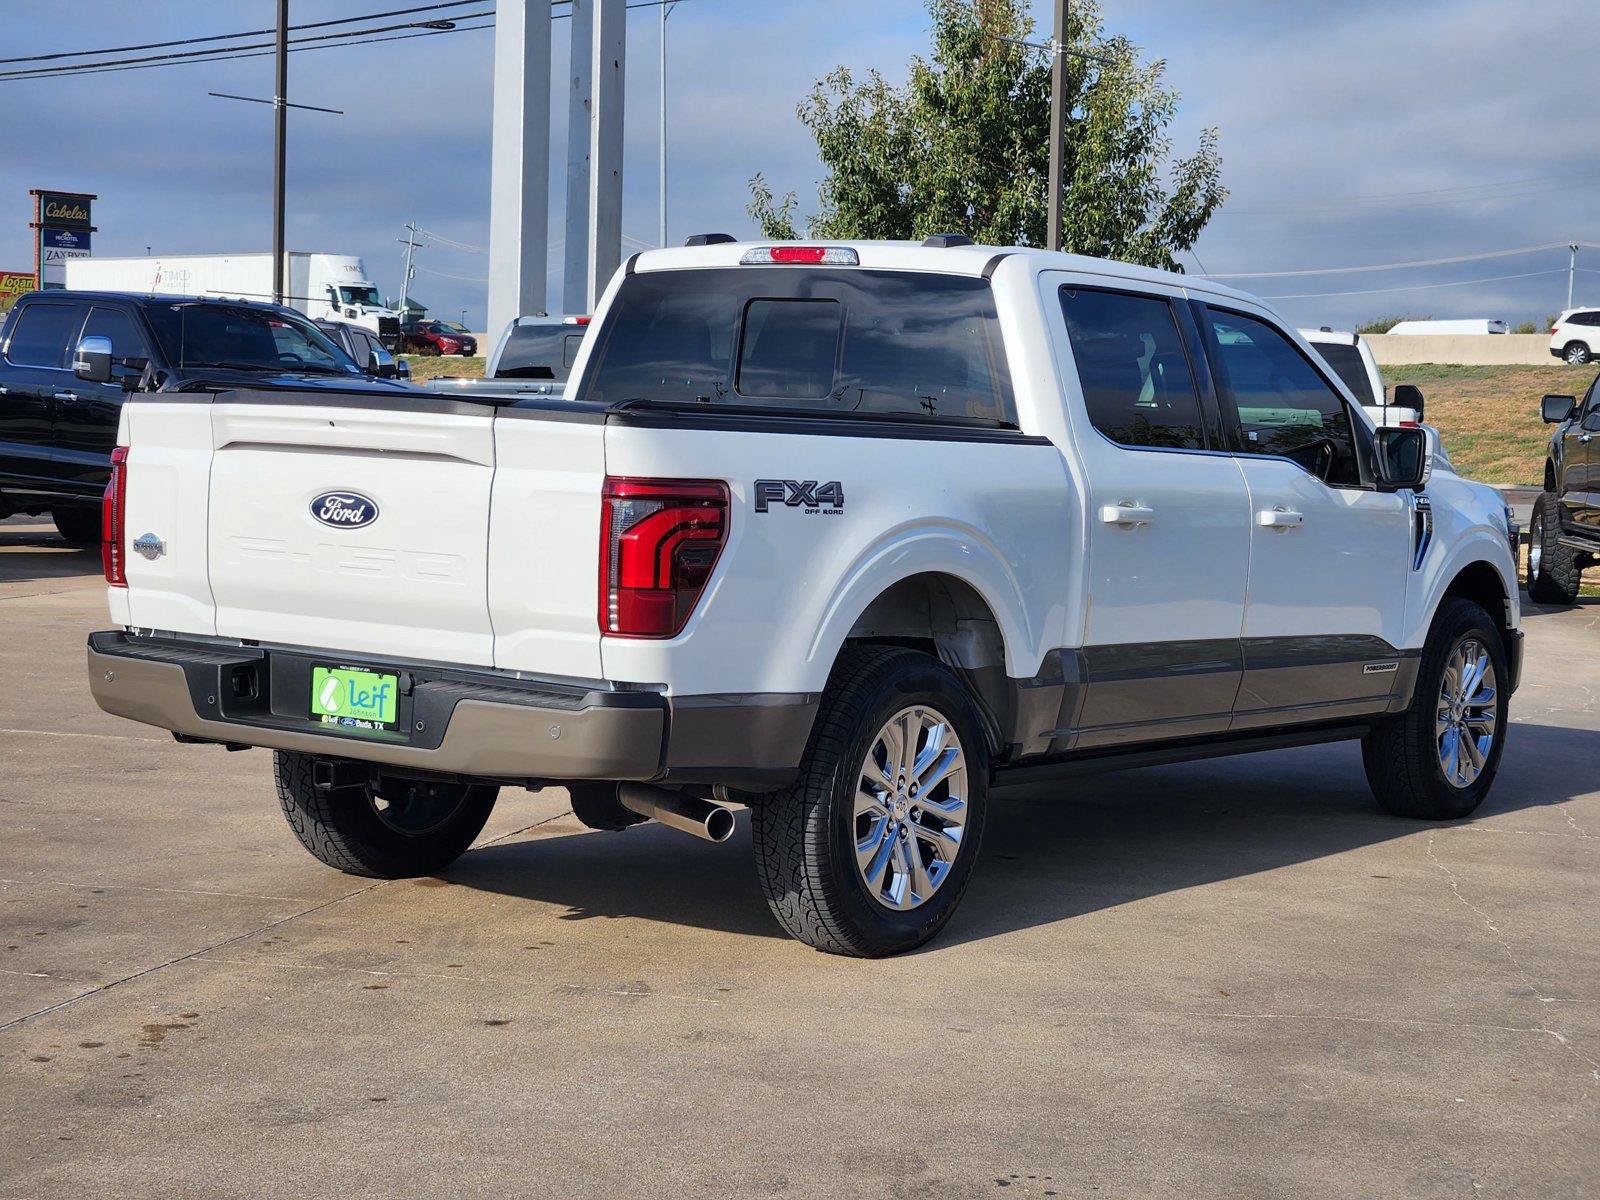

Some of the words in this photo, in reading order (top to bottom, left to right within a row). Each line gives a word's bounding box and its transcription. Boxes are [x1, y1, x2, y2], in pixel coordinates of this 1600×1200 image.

[45, 202, 88, 220] Cabela's
[320, 495, 366, 523] Ford
[754, 479, 844, 513] FX4
[348, 679, 391, 719] leif
